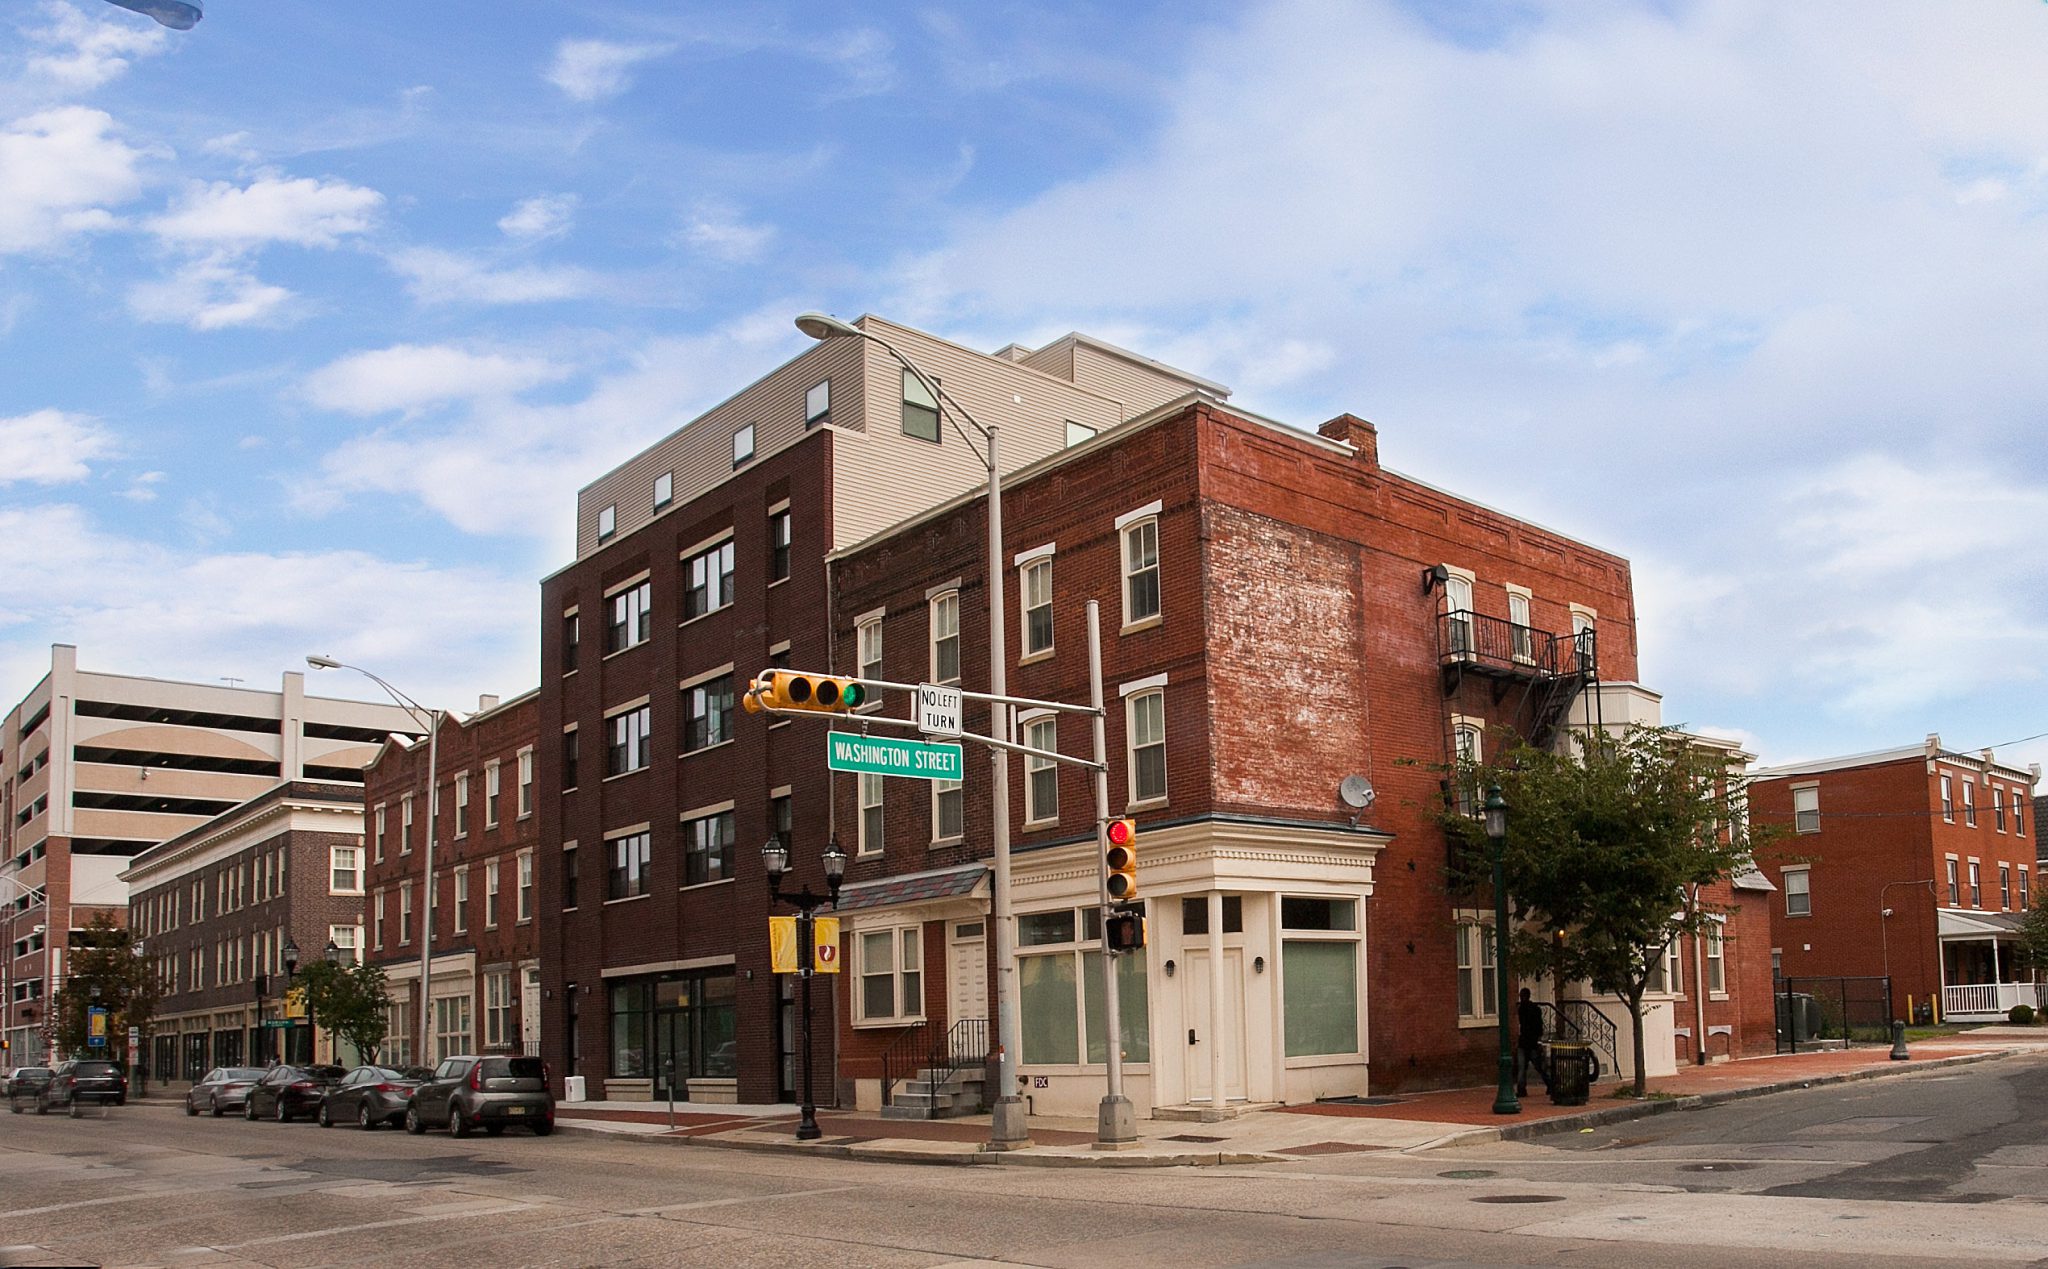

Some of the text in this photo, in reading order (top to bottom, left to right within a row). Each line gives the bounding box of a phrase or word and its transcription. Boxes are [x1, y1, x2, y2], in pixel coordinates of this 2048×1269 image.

[922, 690, 957, 709] NO LEFT
[927, 713, 955, 729] TURN
[835, 741, 956, 771] WASHINGTON STREET
[1035, 1077, 1048, 1087] FDC
